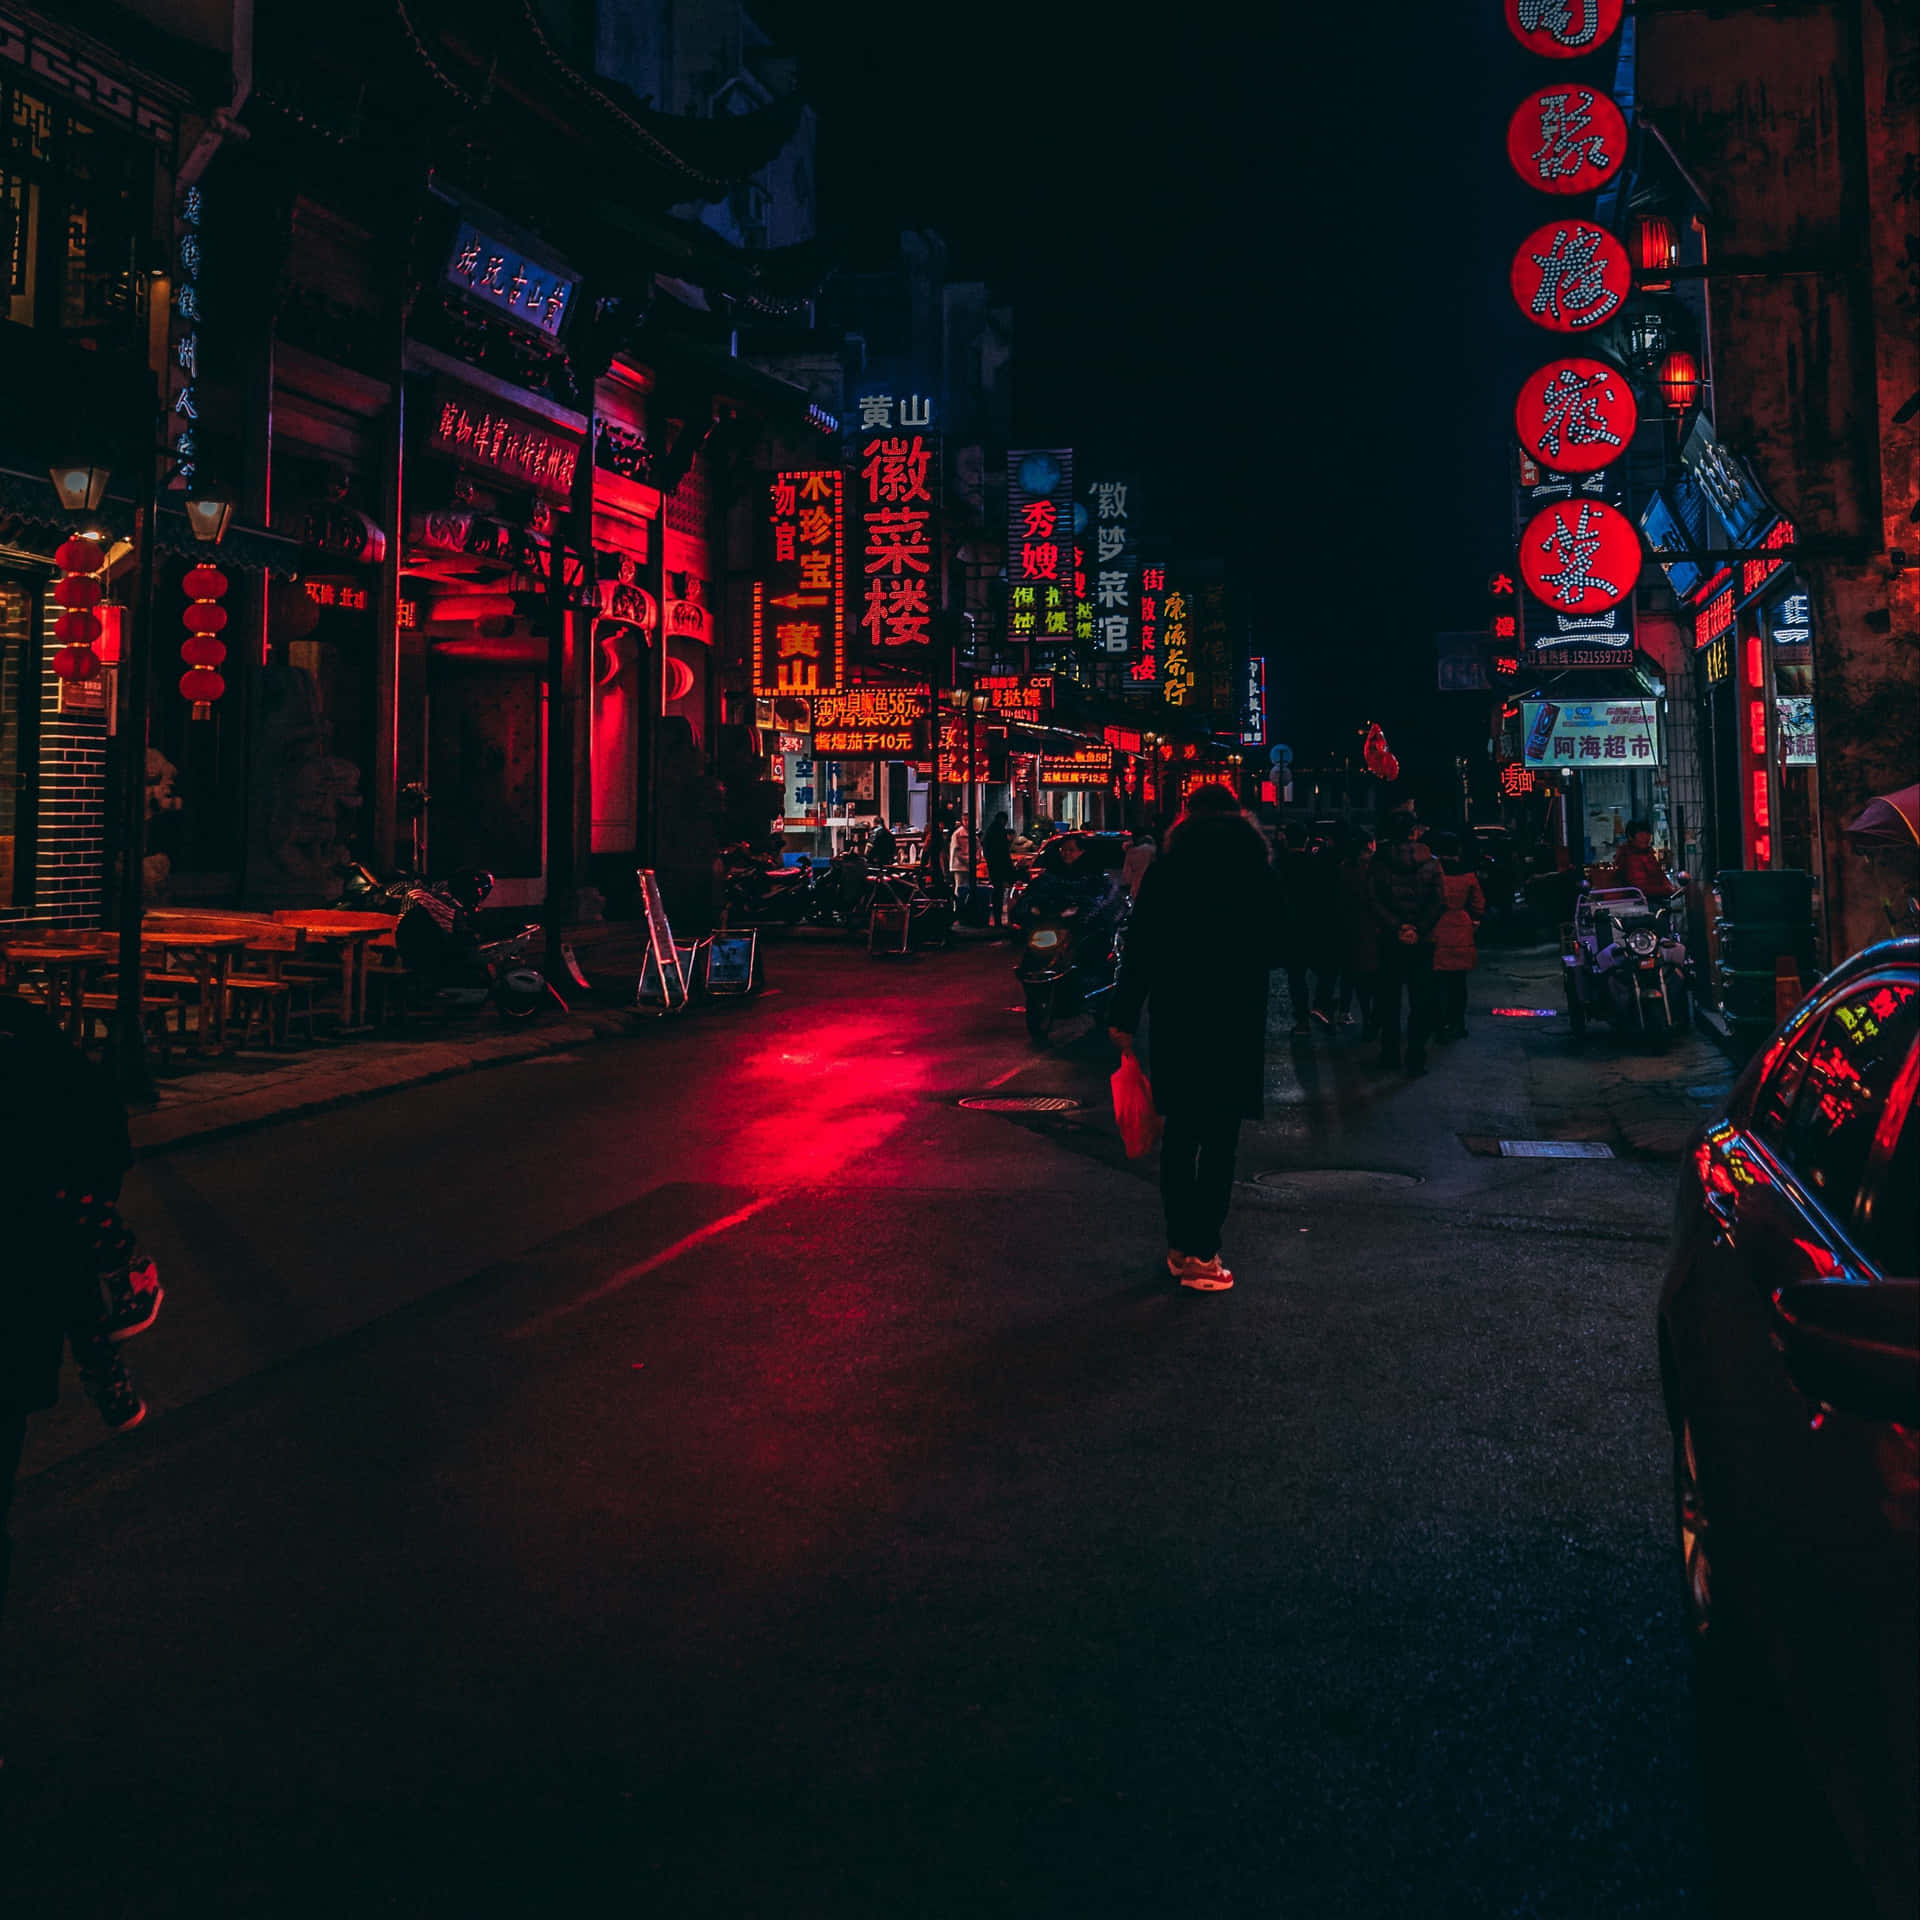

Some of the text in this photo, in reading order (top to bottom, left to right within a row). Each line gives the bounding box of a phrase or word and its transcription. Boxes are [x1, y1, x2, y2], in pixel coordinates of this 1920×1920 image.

[859, 393, 931, 430] 黄山
[860, 434, 932, 647] 徽菜楼
[1019, 500, 1058, 580] 秀嫂
[776, 620, 820, 691] 黄山
[814, 731, 914, 752] 酱爆茄子10元
[1553, 735, 1651, 760] 阿海超市
